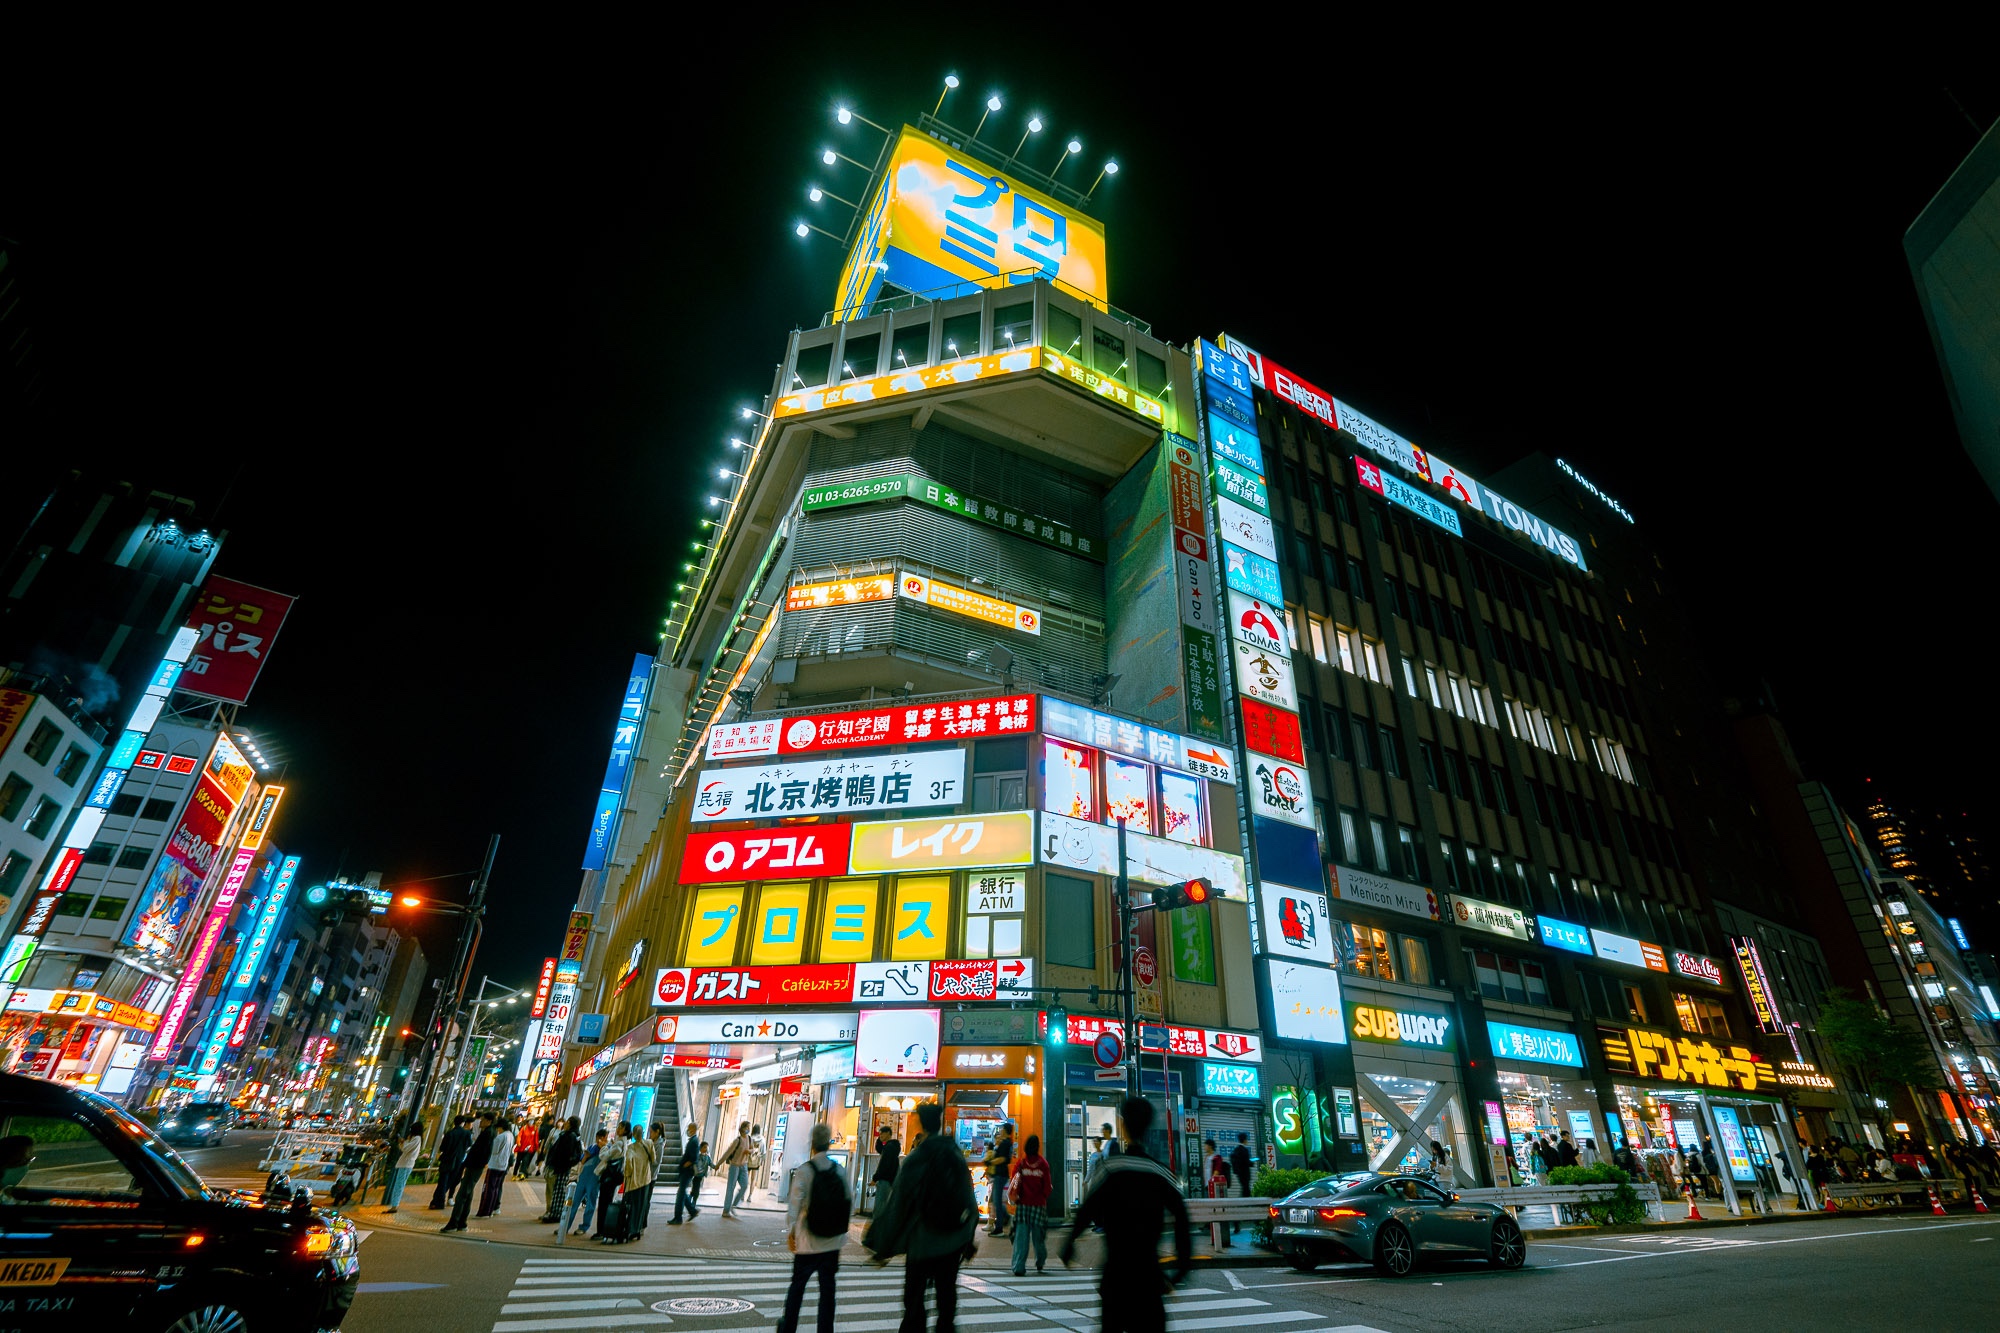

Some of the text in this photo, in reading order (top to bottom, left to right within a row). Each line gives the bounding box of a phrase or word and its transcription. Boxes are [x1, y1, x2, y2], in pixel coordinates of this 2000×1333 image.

[1274, 371, 1333, 423] 日能研
[1341, 409, 1398, 448] コンタクトレンズ
[1215, 440, 1259, 470] 東急リバブル
[1342, 419, 1414, 467] Menicon Miru
[1360, 465, 1380, 488] 本
[807, 480, 901, 505] SJI 03-6265-9570
[1180, 467, 1191, 528] テストセンター
[1384, 477, 1458, 530] 芳林堂書店
[926, 485, 1091, 553] 日本語教師養成講座
[1483, 489, 1579, 564] TOMAS
[1251, 561, 1277, 584] 歯科
[1188, 559, 1202, 620] Can Do
[1275, 608, 1285, 619] 6F
[1241, 628, 1281, 653] TOMAS
[1188, 643, 1204, 712] 日本語学校
[610, 676, 649, 767] カラオケ
[715, 723, 775, 738] 行知学園
[819, 699, 1028, 738] 行知学園 留学生進学指導
[821, 714, 1028, 745] COACH ACADEMY 学部 大学院 美術
[1049, 711, 1229, 780] 一橋学院 徒歩3分
[174, 761, 190, 769] 7F
[698, 772, 956, 814] 民福 北京烤鴨店 3F
[743, 821, 984, 868] アコム レイク
[979, 876, 1015, 895] 銀行
[1348, 874, 1390, 891] コンタクトレンズ
[979, 896, 1014, 910] ATM
[1319, 897, 1327, 917] 2F
[1350, 884, 1421, 911] Menicon Miru
[701, 901, 935, 947] プロミス
[1474, 907, 1516, 931] 蘭州拉麺
[565, 935, 584, 960] DVD
[933, 961, 995, 970] しゃぶしゃぶバイキング
[660, 983, 683, 994] ガスト
[693, 971, 996, 1000] ガスト Caféレストラン 2F しゃぶ葉
[548, 1004, 568, 1020] 50
[544, 1023, 564, 1034] 生中
[721, 1022, 754, 1038] Can
[774, 1022, 799, 1037] Do
[1354, 1005, 1449, 1045] SUBWAY
[541, 1034, 561, 1047] 190
[1510, 1031, 1573, 1063] 東急リバブル
[707, 1058, 730, 1068] ガスト
[956, 1054, 1006, 1067] RELX
[1206, 1066, 1255, 1084] アパ・マン
[1215, 1084, 1250, 1096] 入口はこちら
[1, 1262, 57, 1281] IKEDA
[156, 1266, 186, 1278] 足立
[26, 1297, 75, 1312] TAXI
